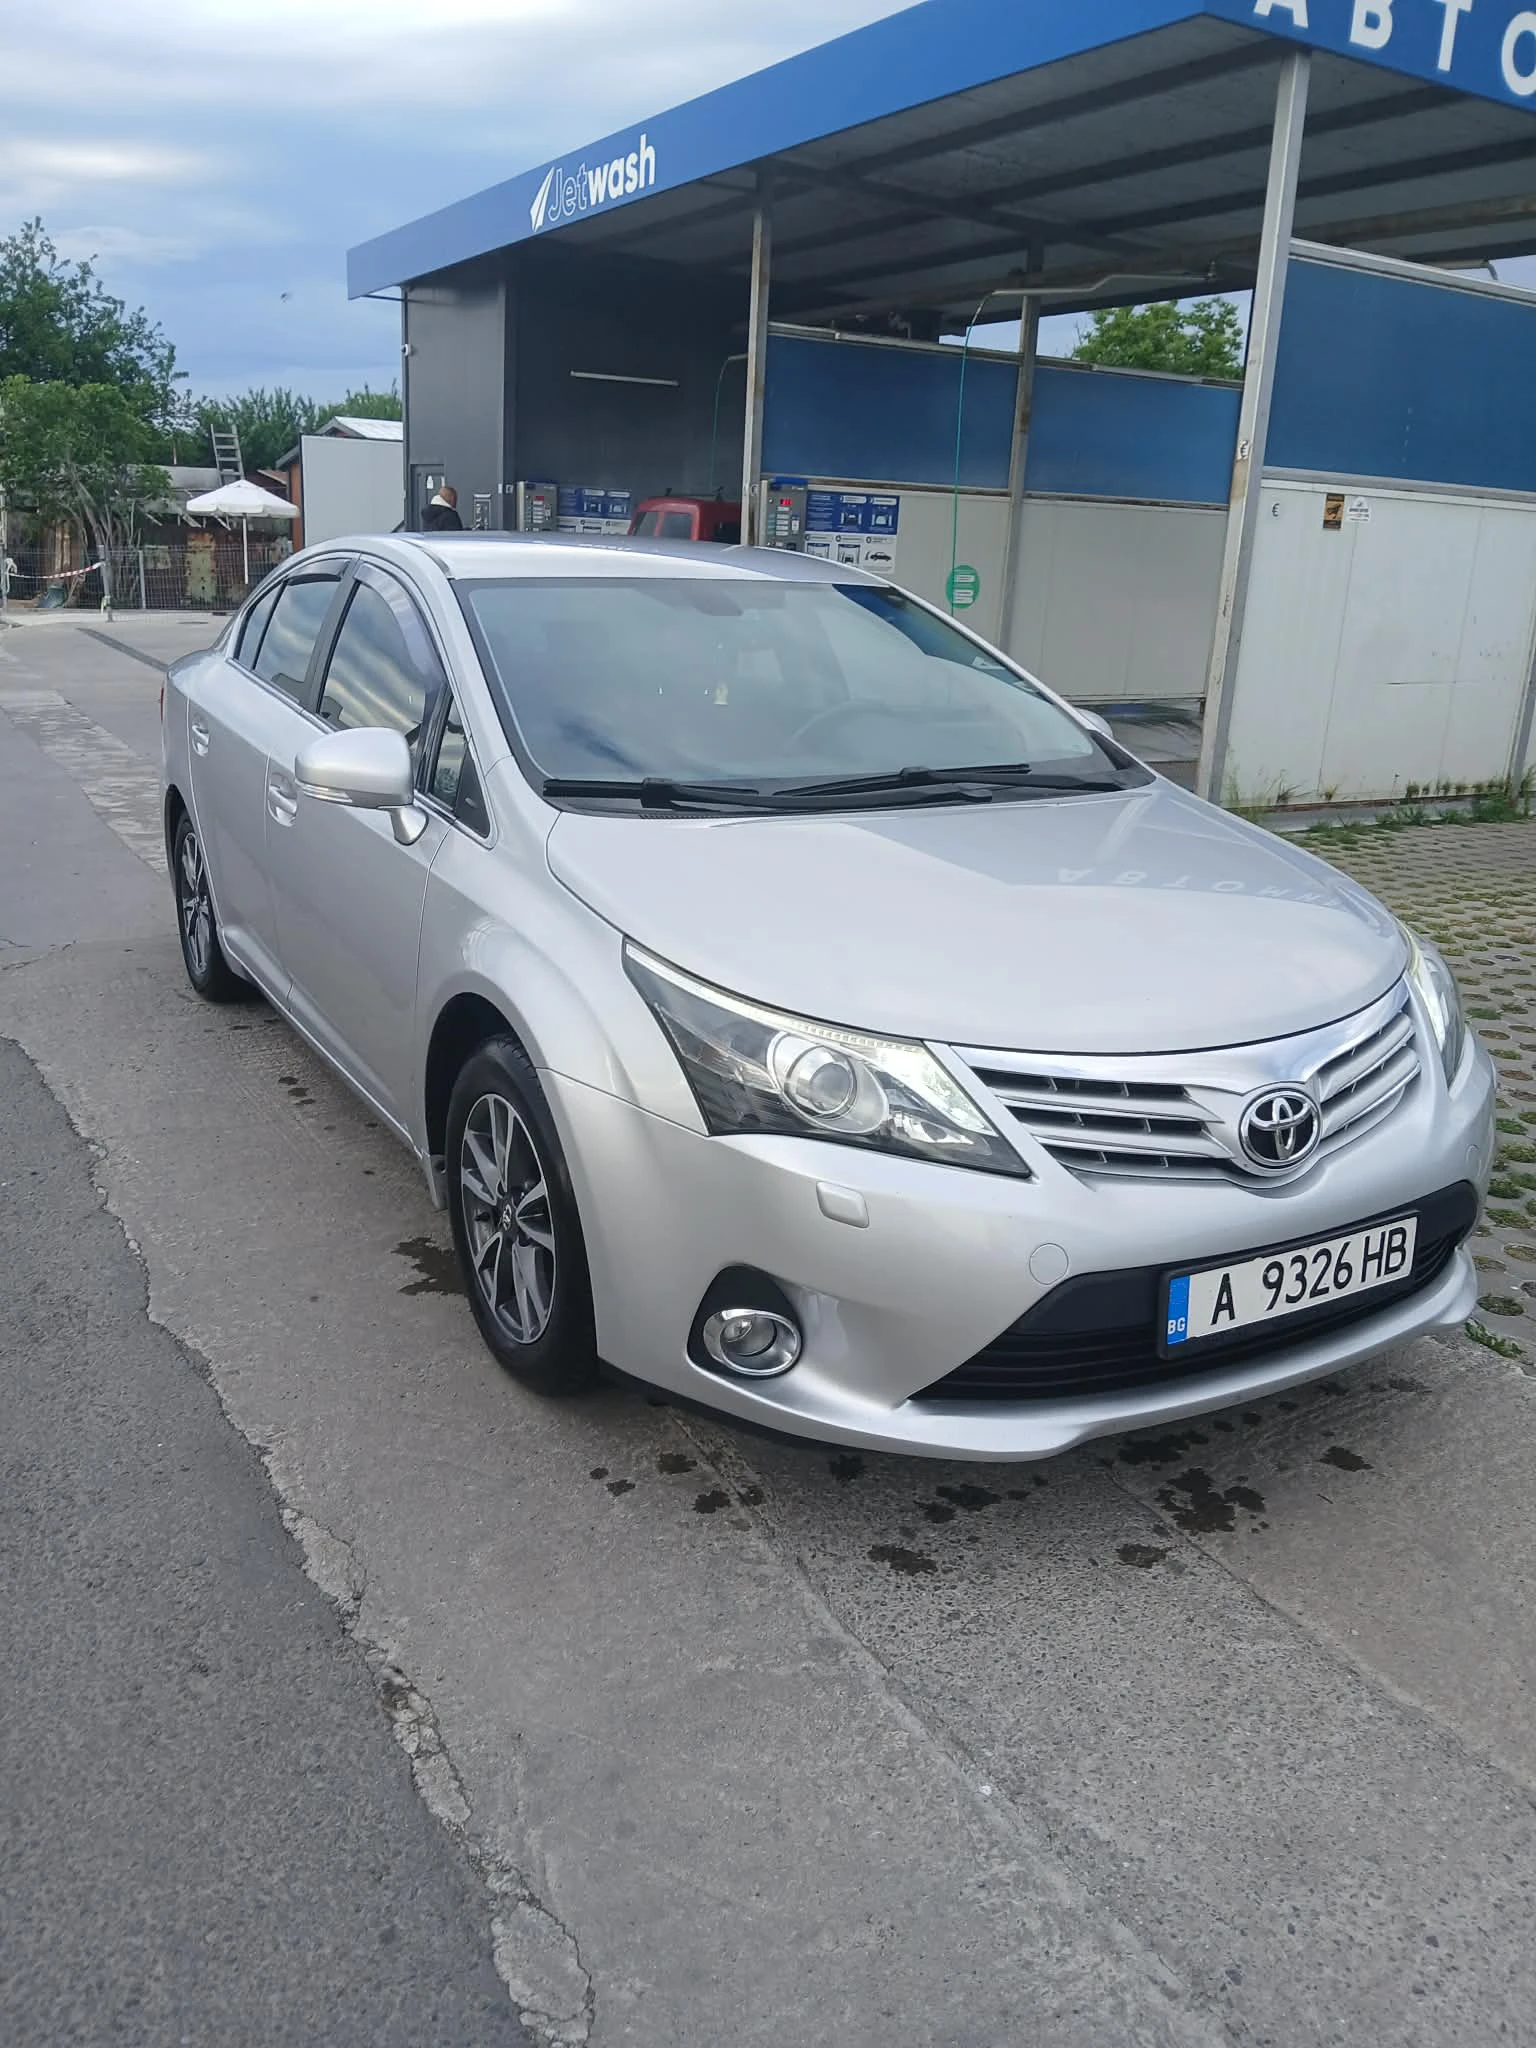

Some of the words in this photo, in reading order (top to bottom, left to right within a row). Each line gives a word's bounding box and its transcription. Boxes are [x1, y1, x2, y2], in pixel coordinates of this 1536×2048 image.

[547, 133, 656, 222] Jetwash
[1167, 1318, 1186, 1335] BG
[1262, 1241, 1353, 1312] 9326
